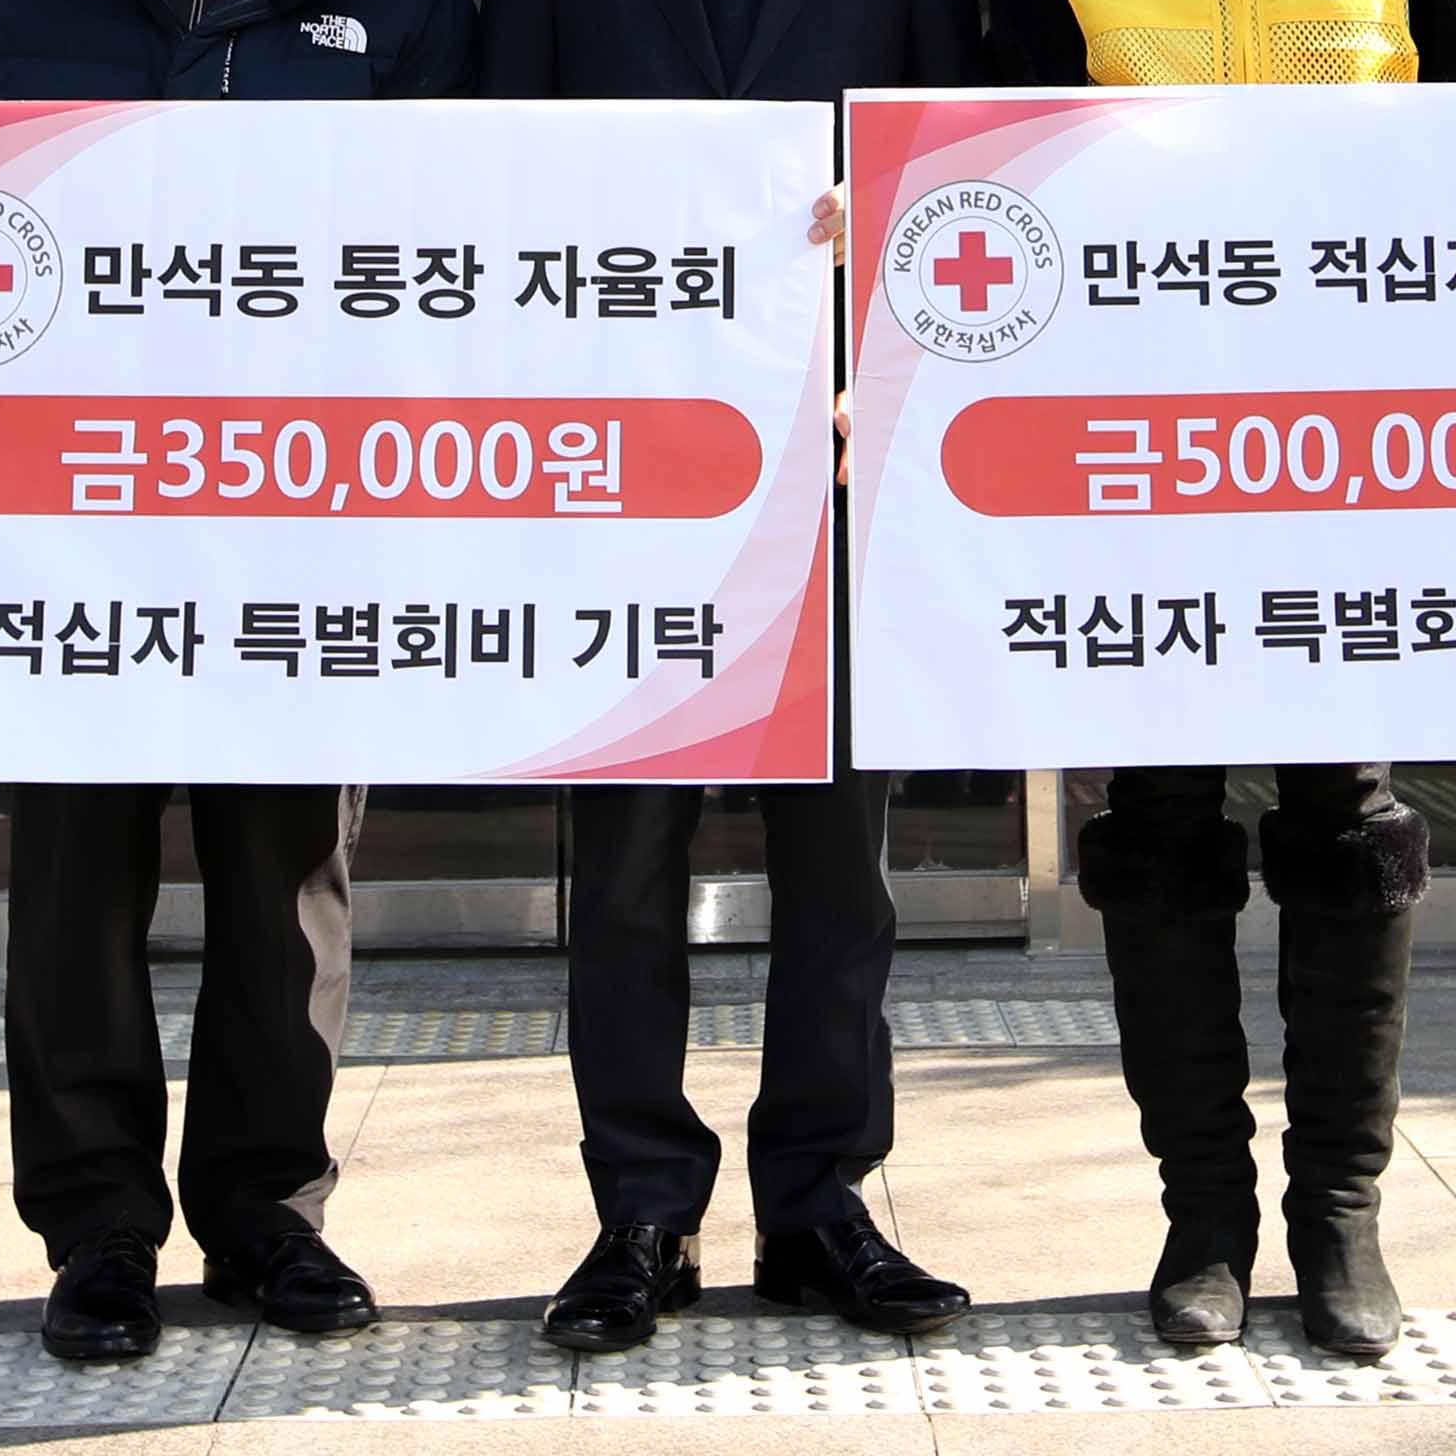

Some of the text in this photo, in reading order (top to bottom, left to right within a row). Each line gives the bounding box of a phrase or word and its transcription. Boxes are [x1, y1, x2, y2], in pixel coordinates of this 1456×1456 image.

[300, 22, 345, 38] NORTH
[312, 33, 344, 49] FACE
[320, 14, 346, 25] THE
[8, 212, 52, 277] CROSS
[894, 191, 1053, 273] KOREAN RED CROSS
[83, 244, 736, 319] 만석동 통장 자율회
[1083, 237, 1281, 306] 만석동
[913, 309, 1037, 354] 대한적십자사
[61, 417, 624, 513] 금350,000원
[233, 600, 536, 678] 특별회비
[572, 602, 723, 679] 기탁
[1001, 589, 1226, 668] 적십자
